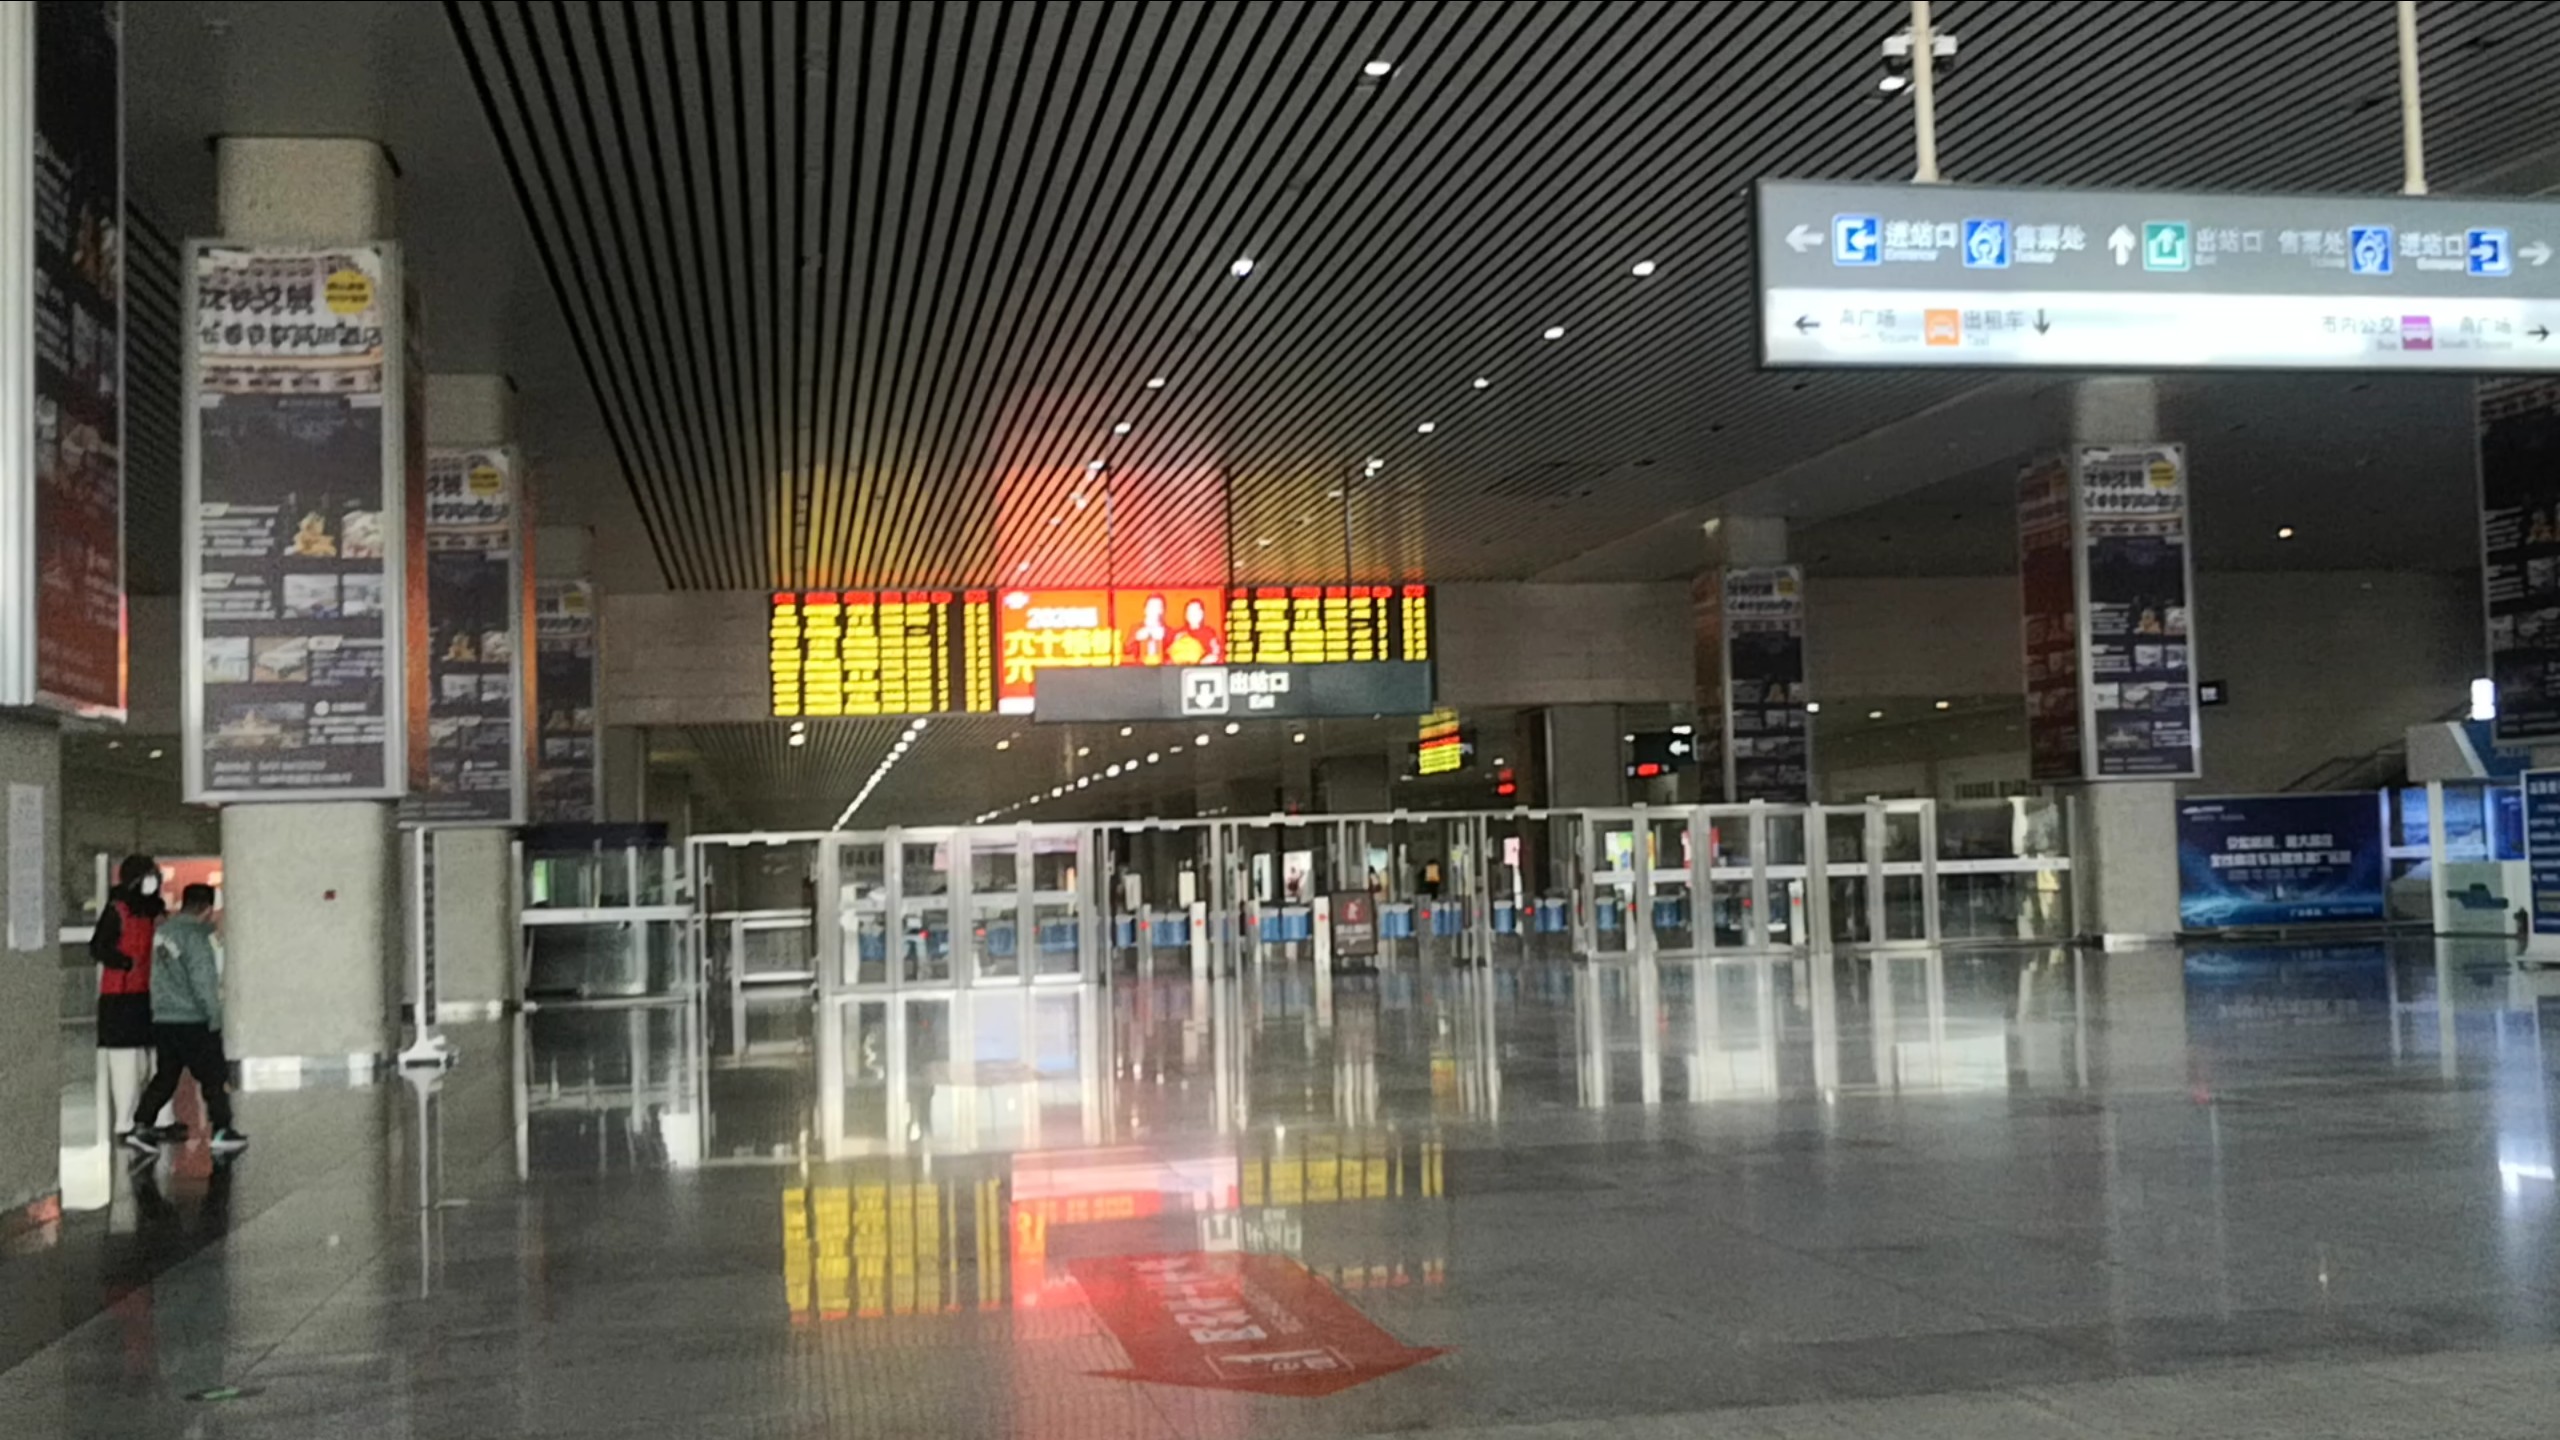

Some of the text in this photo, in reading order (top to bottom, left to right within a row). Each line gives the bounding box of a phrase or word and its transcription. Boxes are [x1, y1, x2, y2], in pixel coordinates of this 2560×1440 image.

[1884, 220, 1958, 249] 进站口
[2014, 224, 2087, 250] 售票处
[2195, 226, 2263, 254] 出站口
[2278, 230, 2346, 256] 售票处
[2400, 231, 2465, 257] 进站口
[1963, 308, 2024, 331] 出租车
[2321, 315, 2398, 334] 市内公交
[1966, 332, 1991, 346] Taxi
[2376, 338, 2398, 351] Bus
[1229, 669, 1290, 694] 出站口
